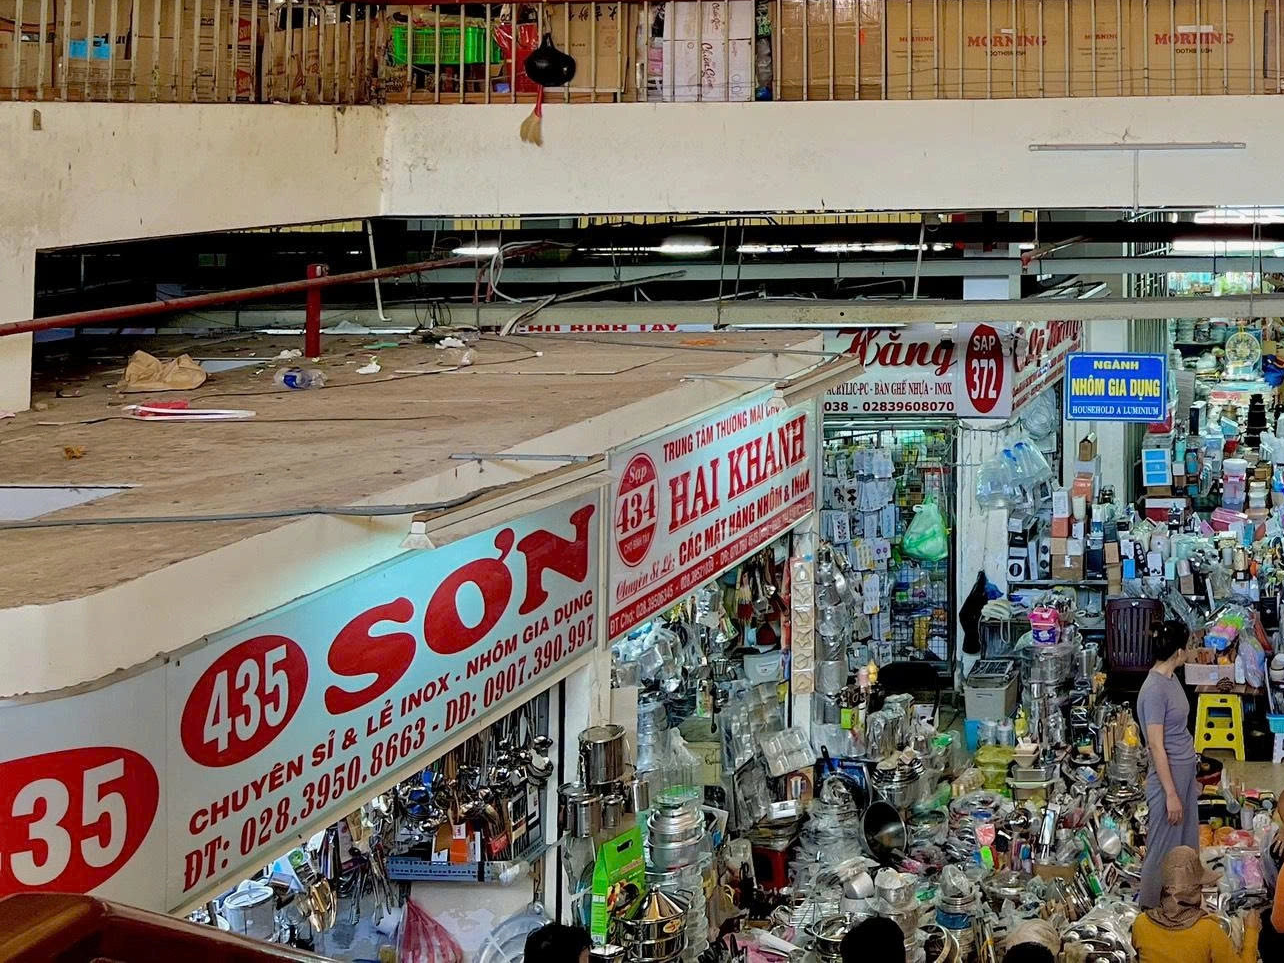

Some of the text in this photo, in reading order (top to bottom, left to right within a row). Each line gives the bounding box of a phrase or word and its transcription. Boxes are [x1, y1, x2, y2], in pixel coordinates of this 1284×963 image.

[973, 336, 996, 355] SẠP
[1094, 359, 1139, 370] NGÀNH
[875, 381, 889, 395] BÀN
[891, 378, 907, 395] GHẾ
[909, 379, 928, 397] NHỰA
[934, 382, 952, 395] INOX
[971, 358, 997, 400] 372
[1071, 375, 1160, 401] NHÔM GIA DỤNG
[862, 401, 954, 412] 02839608070
[1072, 406, 1159, 415] HOUSEHOLD LUMINIUM
[663, 404, 764, 463] TRUNG TÂM THƯƠNG MẠI
[629, 463, 647, 486] Sạp
[668, 457, 720, 534] HAI
[727, 414, 808, 502] KHANH
[616, 484, 656, 534] 434
[679, 531, 701, 566] CÁC
[705, 517, 727, 551] MẶT
[729, 502, 755, 536] HÀNG
[757, 487, 782, 519] NHÔM
[792, 468, 810, 498] INOX
[324, 504, 595, 715] SƠN
[189, 589, 594, 836] CHUYÊN SỈ & LẺ INOX NHÔM GIA DỤNG
[203, 644, 289, 753] 435
[182, 614, 595, 893] ĐT: 028.3950.8663 DĐ: 0907.390.997
[0, 758, 127, 886] 35
